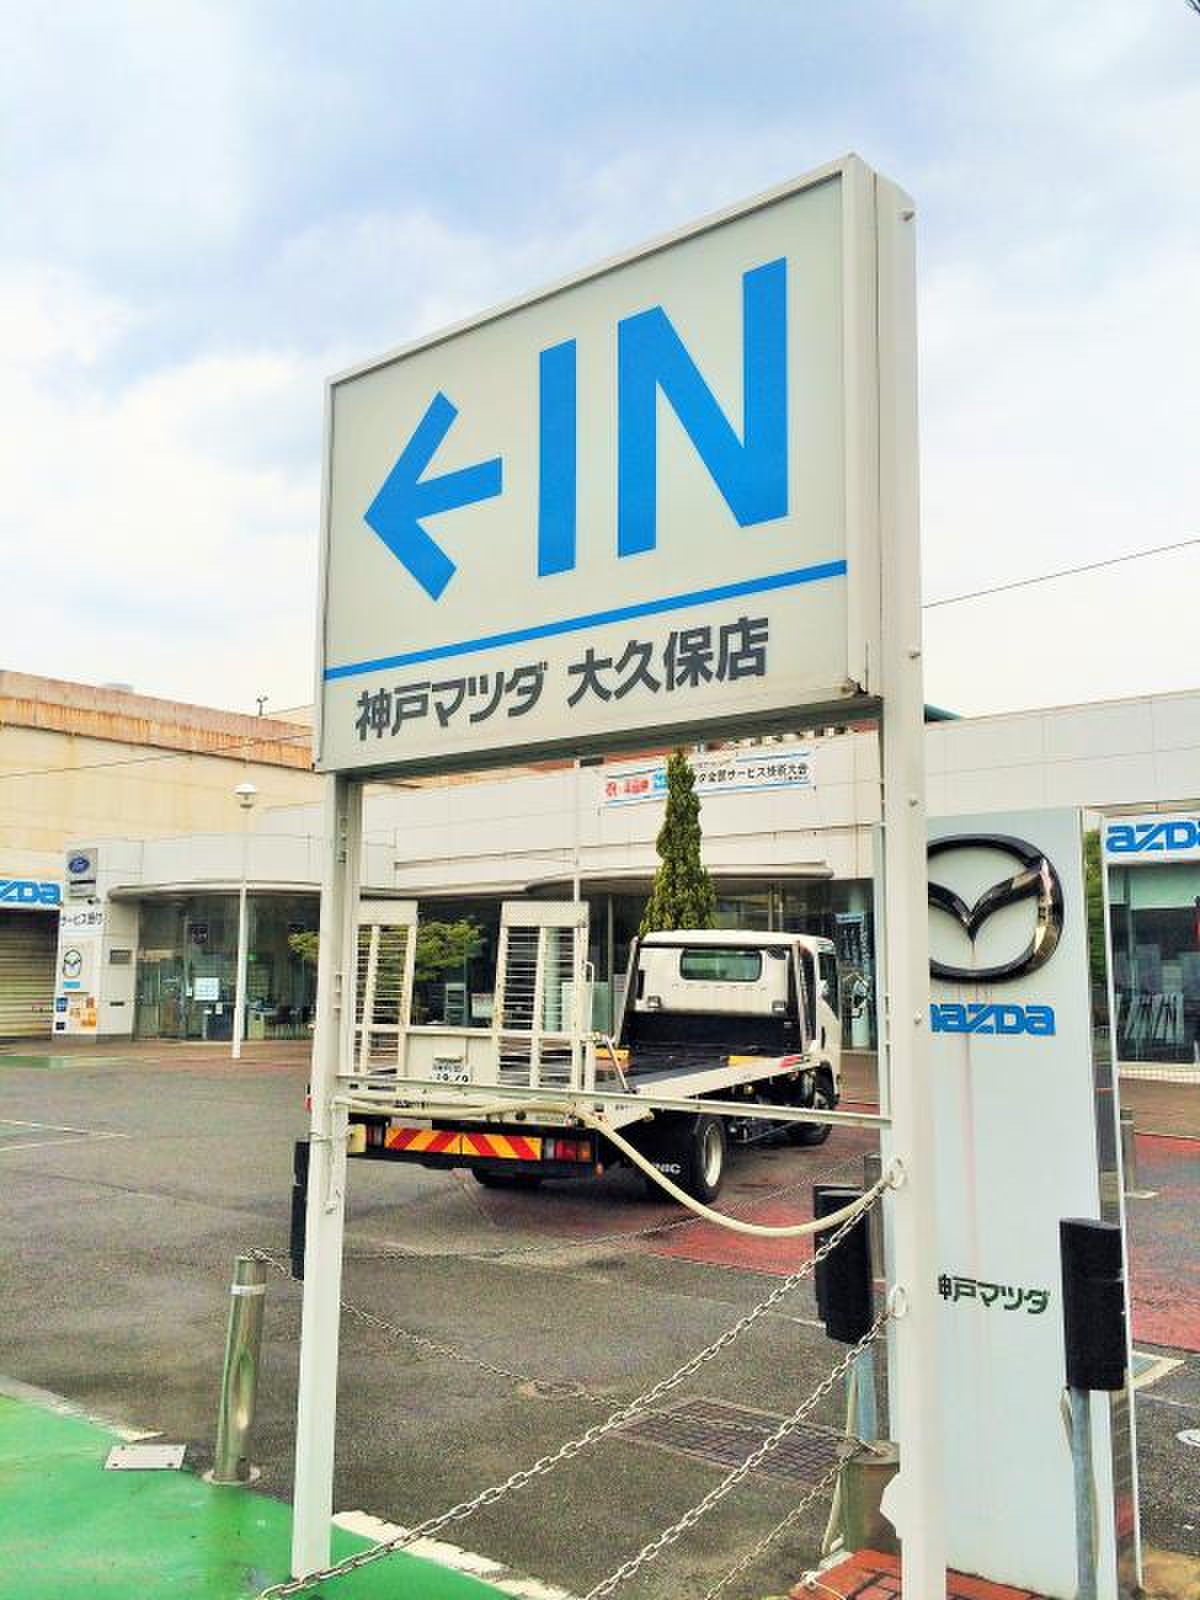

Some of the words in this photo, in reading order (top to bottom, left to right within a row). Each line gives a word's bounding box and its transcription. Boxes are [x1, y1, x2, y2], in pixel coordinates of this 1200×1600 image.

[538, 256, 788, 577] IN
[355, 661, 548, 742] 神戸マツダ
[567, 616, 769, 708] 大久保店
